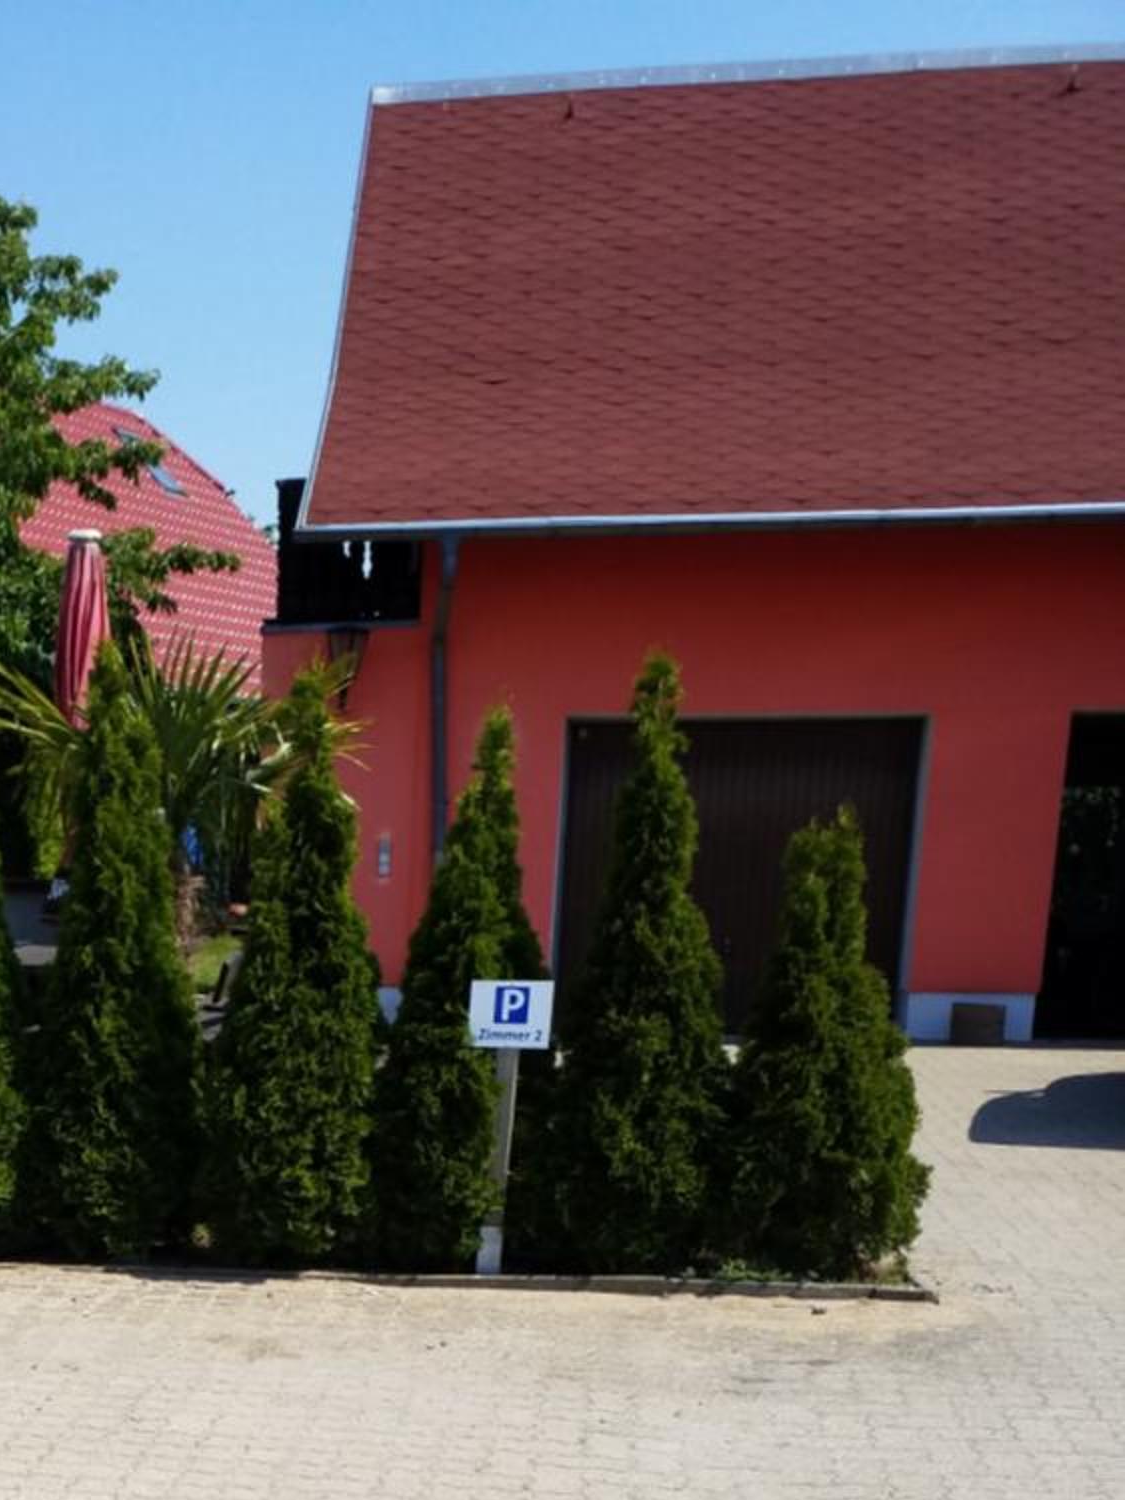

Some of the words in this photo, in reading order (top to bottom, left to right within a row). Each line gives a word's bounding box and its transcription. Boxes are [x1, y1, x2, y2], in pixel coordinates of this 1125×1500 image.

[501, 989, 525, 1021] P
[478, 1028, 531, 1041] Zimmer
[534, 1029, 542, 1042] 2
